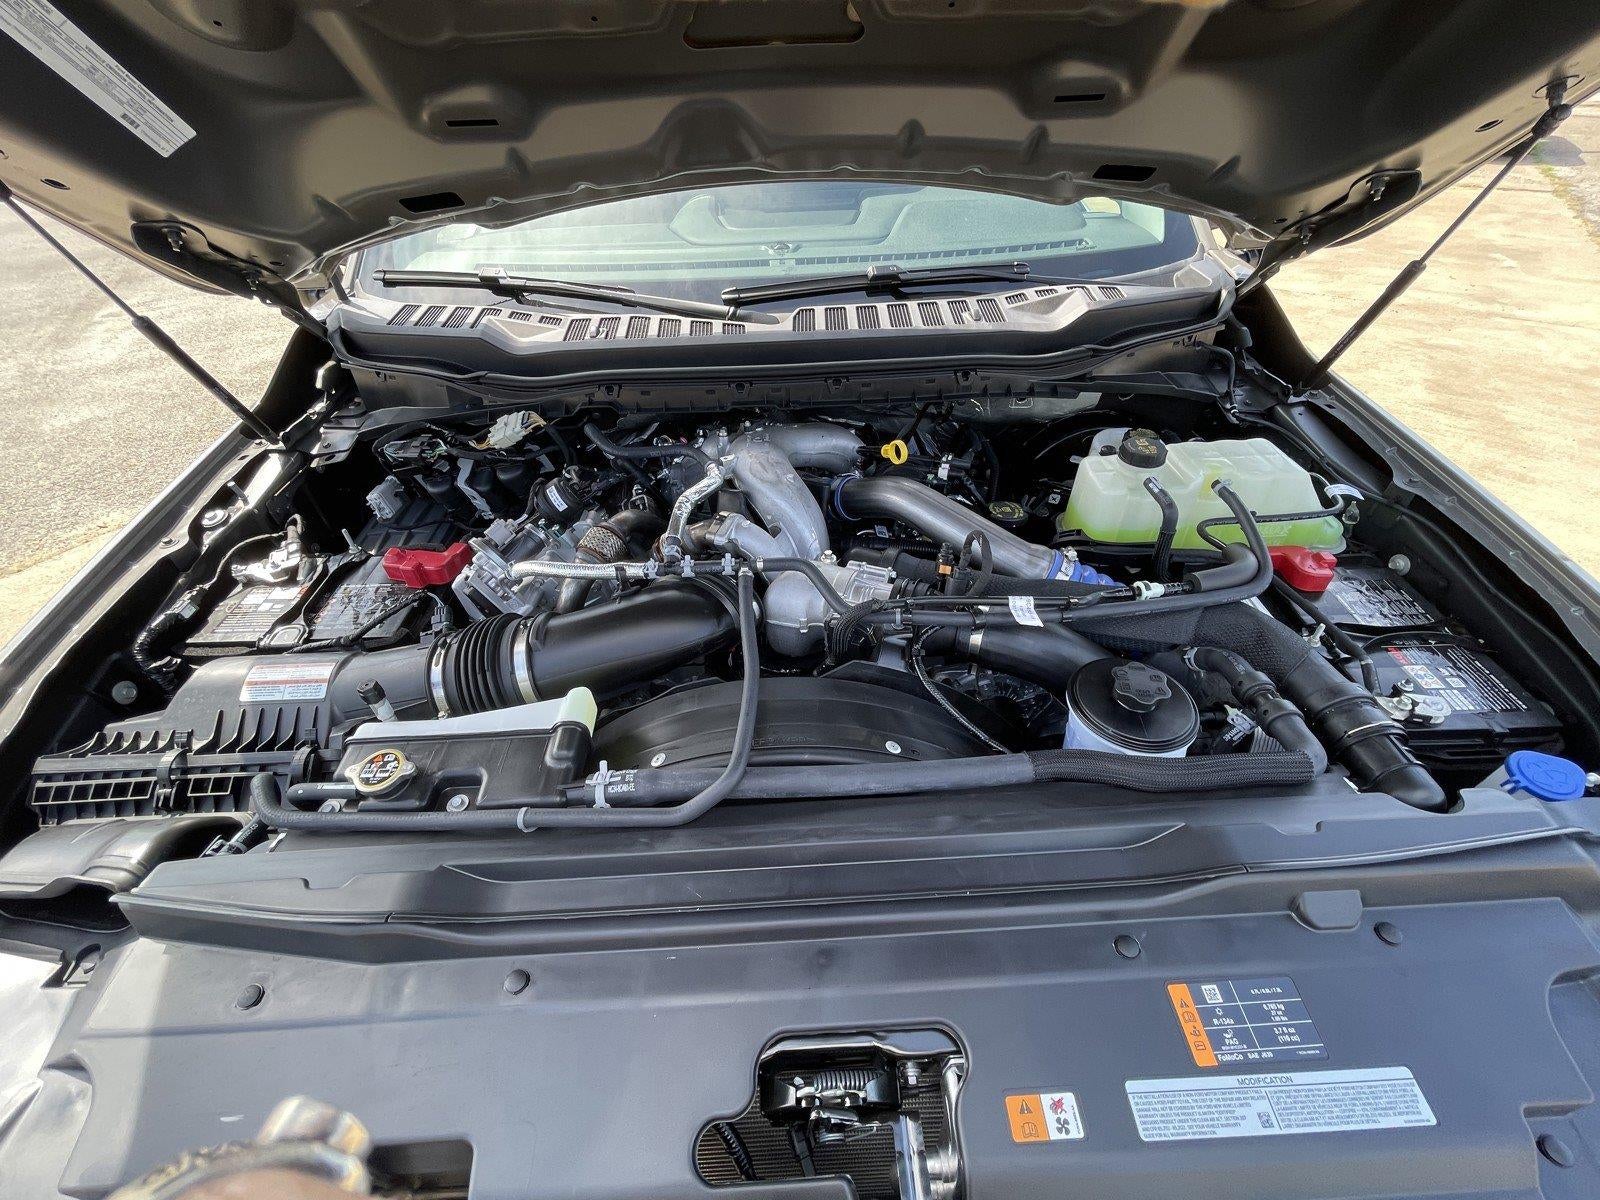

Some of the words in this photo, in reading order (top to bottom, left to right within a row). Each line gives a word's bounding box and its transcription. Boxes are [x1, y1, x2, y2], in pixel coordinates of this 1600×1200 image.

[1212, 1017, 1235, 1026] R-134a
[1224, 1038, 1239, 1046] PAG
[1217, 1053, 1244, 1062] FoMoCo
[1236, 1075, 1293, 1086] MODIFICATION
